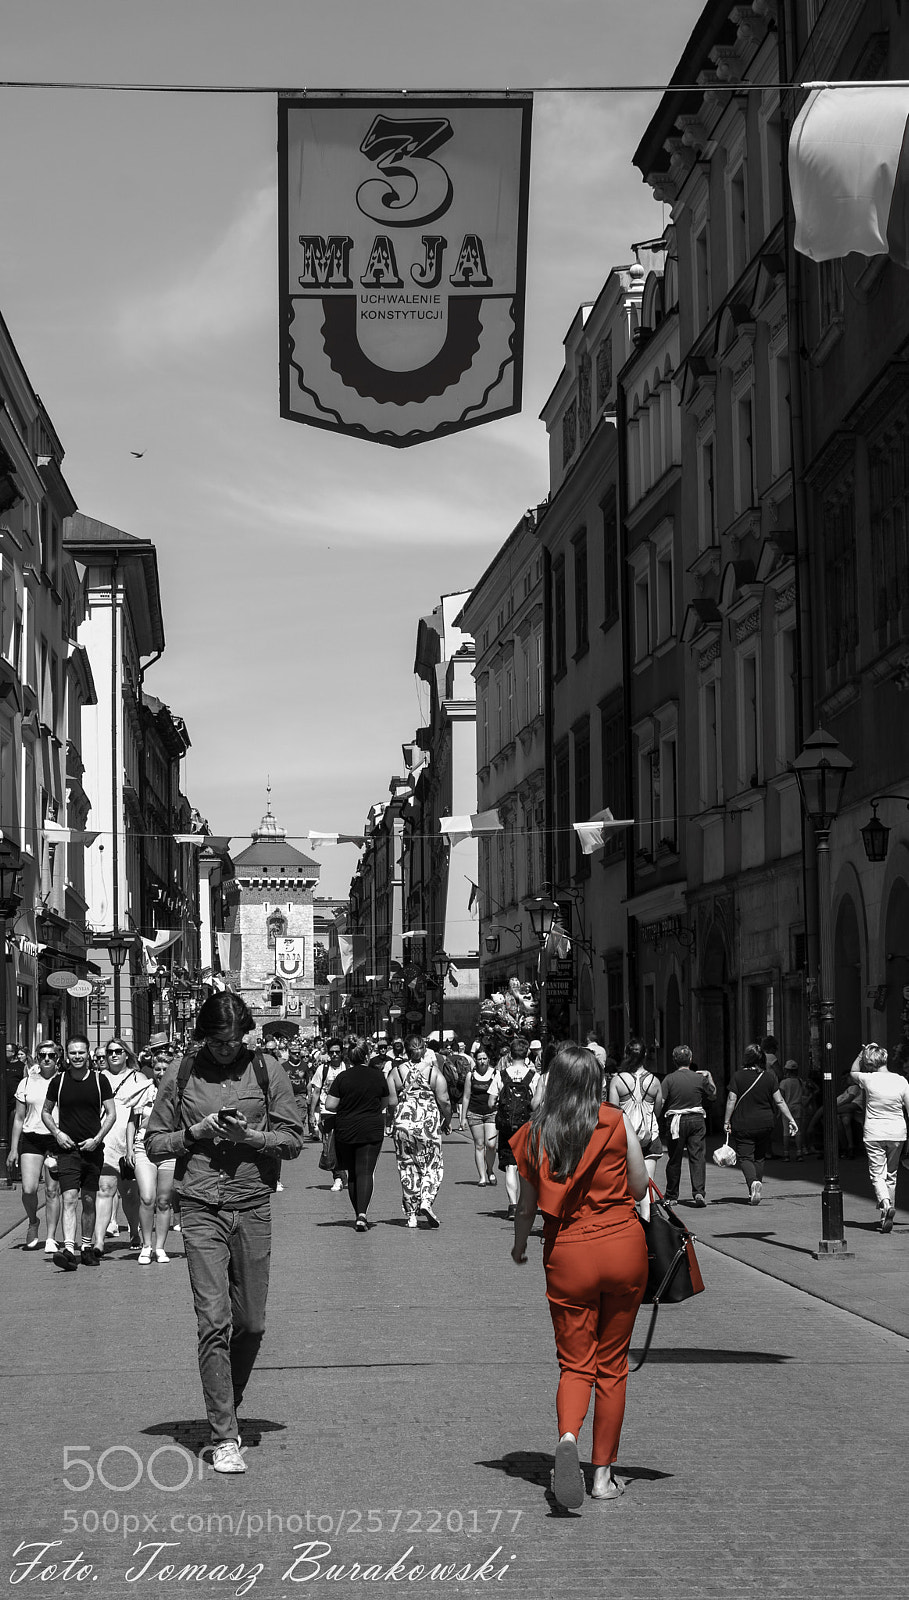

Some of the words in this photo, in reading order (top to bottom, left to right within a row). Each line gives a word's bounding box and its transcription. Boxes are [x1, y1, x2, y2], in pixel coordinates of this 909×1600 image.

[355, 113, 454, 228] 3
[299, 234, 493, 289] MAJA
[360, 294, 441, 304] UCHWALENIE
[360, 310, 443, 320] KONSTYTUCJI
